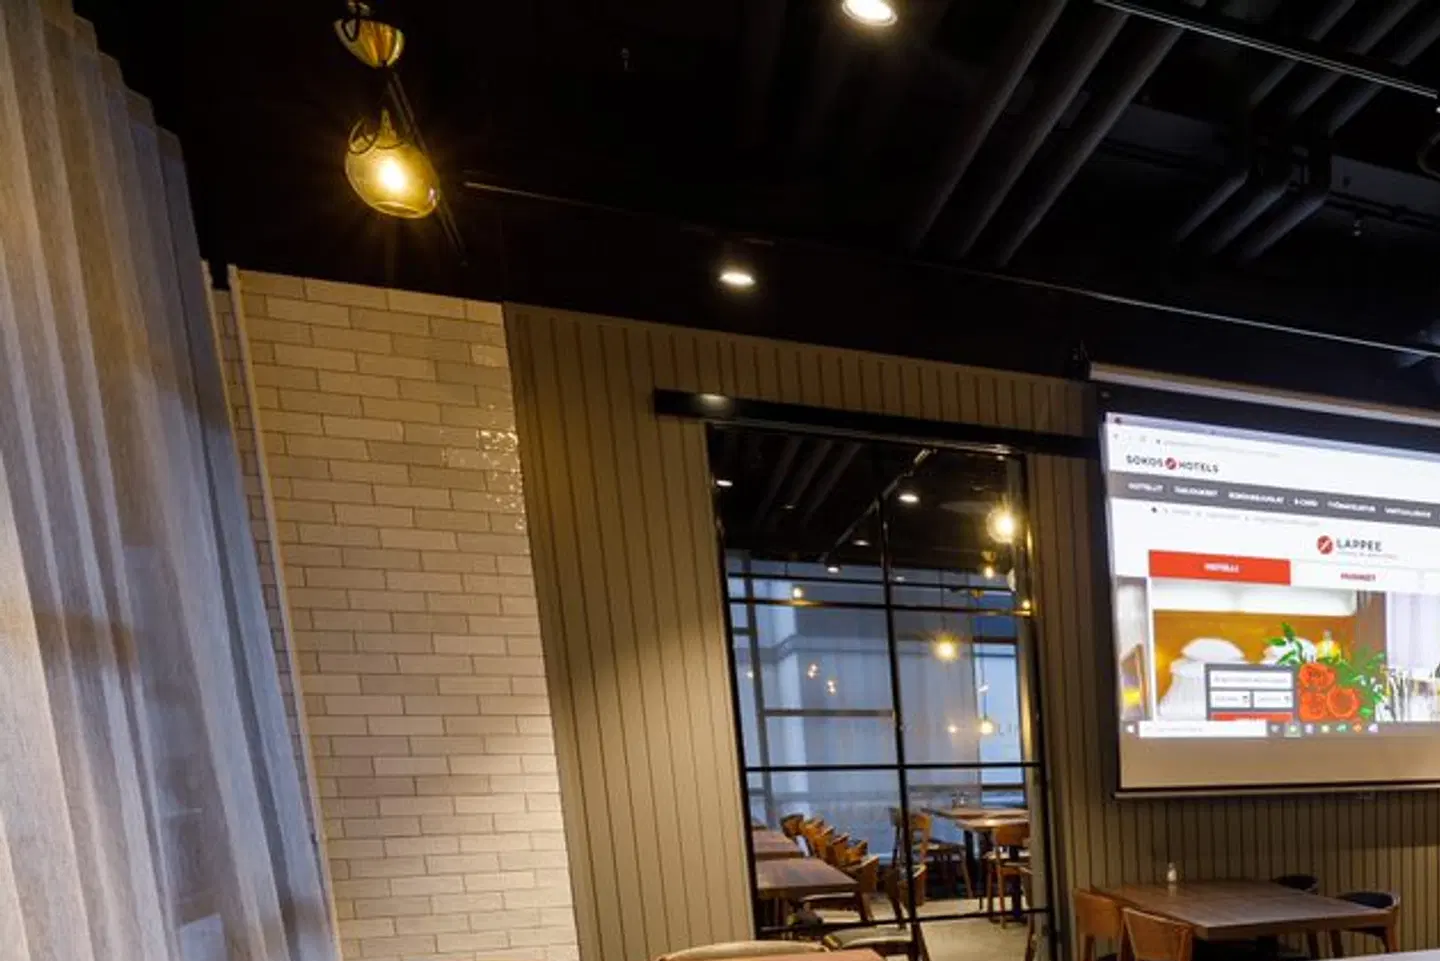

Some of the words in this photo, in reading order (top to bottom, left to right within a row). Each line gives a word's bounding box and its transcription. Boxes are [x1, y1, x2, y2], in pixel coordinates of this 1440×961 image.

[1126, 454, 1163, 467] SOKOS
[1178, 460, 1219, 473] HOTELS
[1336, 538, 1383, 552] LAPPEE
